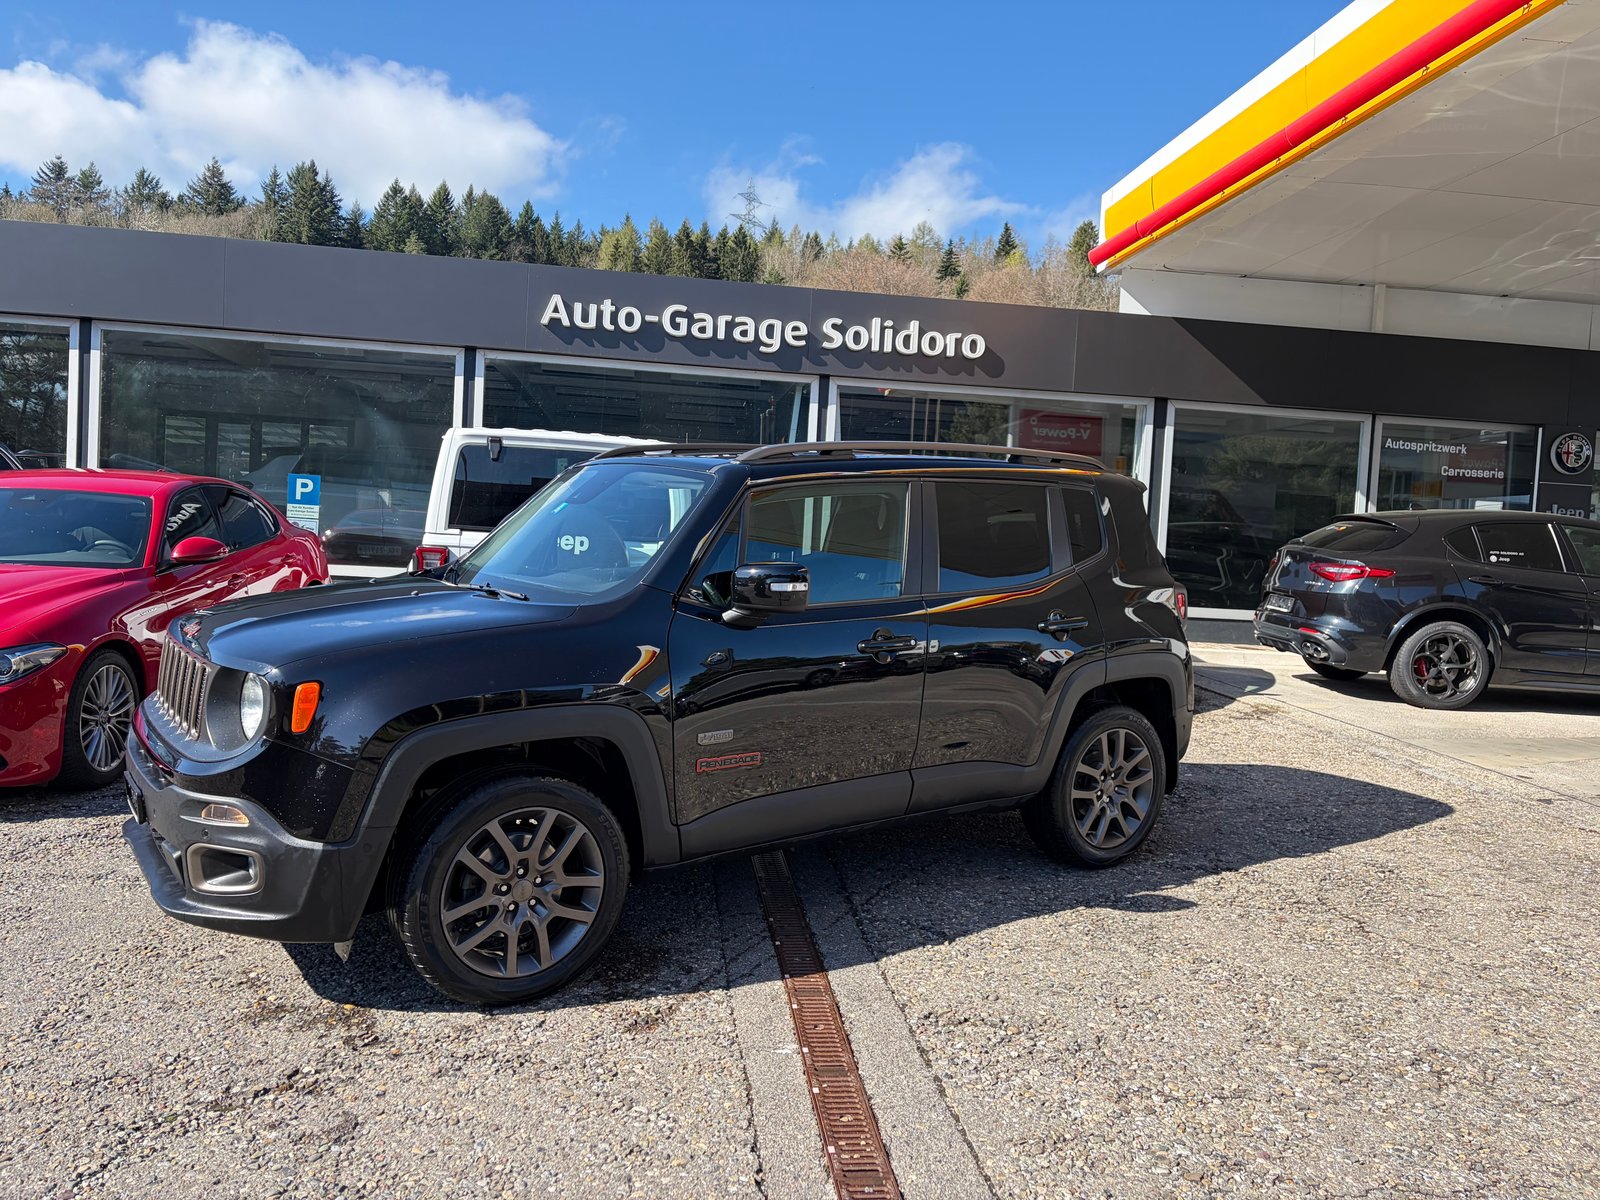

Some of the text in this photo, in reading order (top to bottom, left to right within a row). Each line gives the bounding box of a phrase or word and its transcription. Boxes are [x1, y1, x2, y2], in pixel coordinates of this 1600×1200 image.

[540, 294, 986, 359] Auto-Garage Solidoro
[1385, 438, 1468, 455] Autospritzwerk
[1441, 465, 1505, 479] Carrosserie
[295, 478, 314, 500] P
[698, 753, 760, 770] RENEGADE
